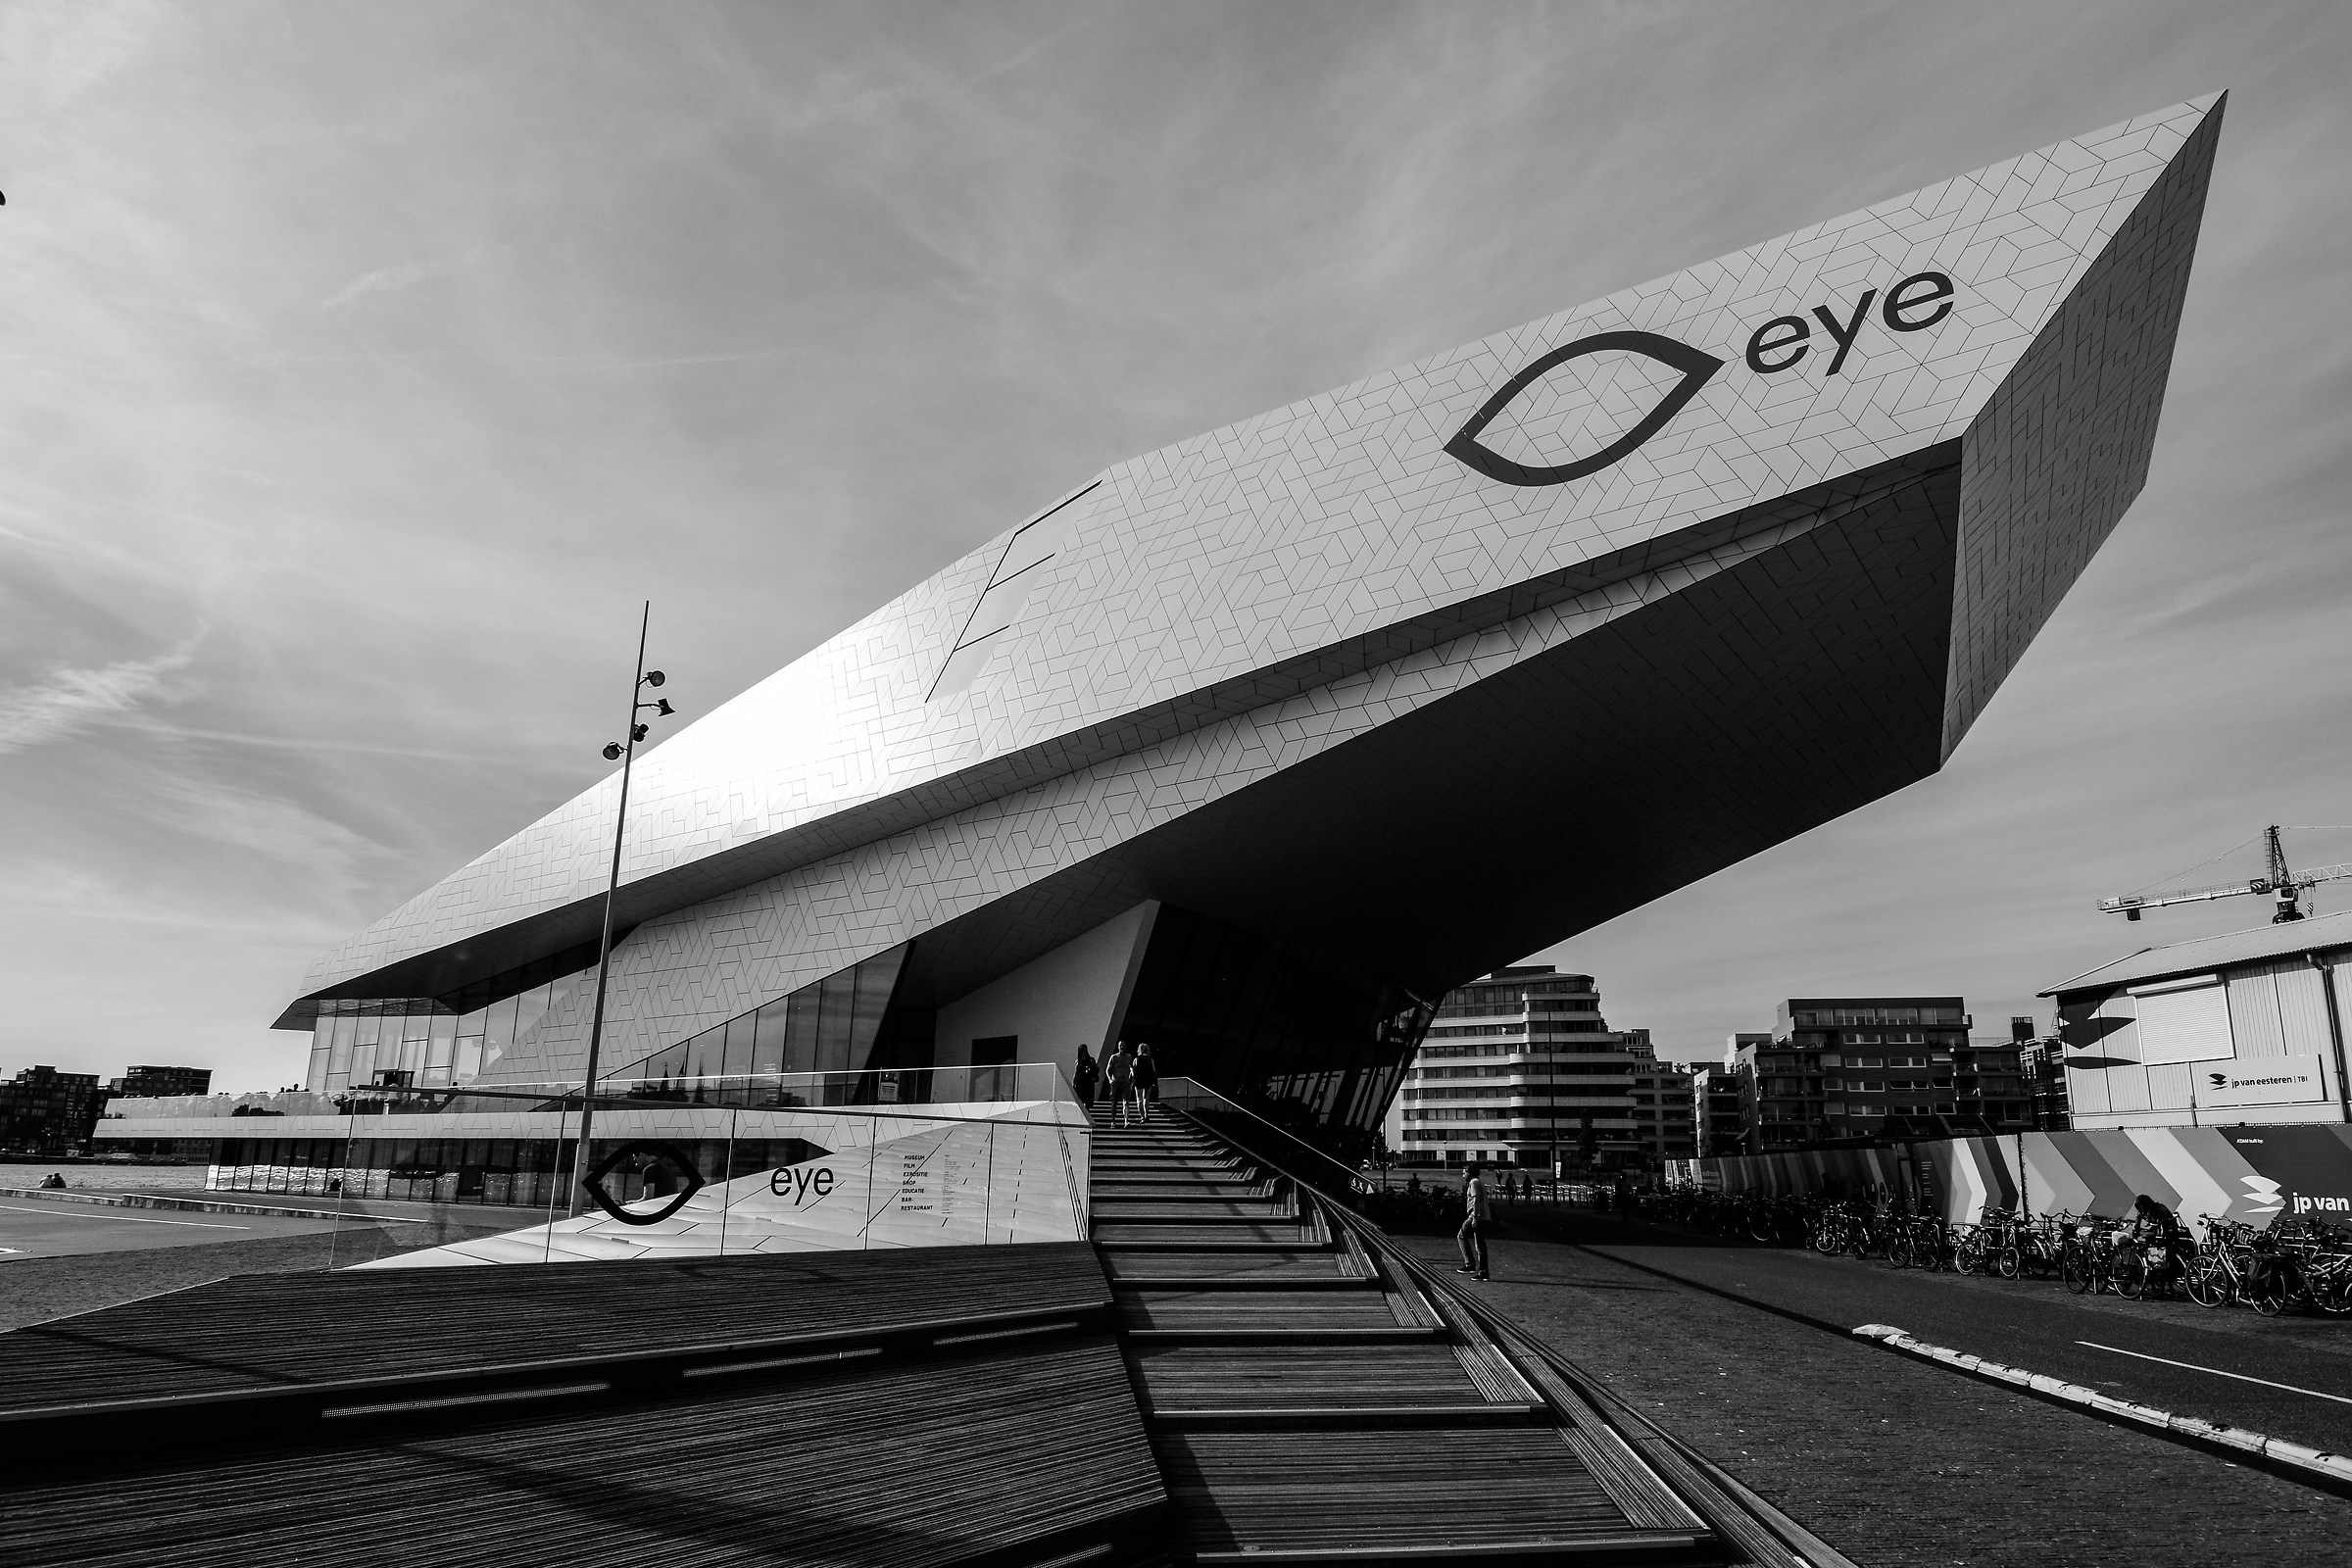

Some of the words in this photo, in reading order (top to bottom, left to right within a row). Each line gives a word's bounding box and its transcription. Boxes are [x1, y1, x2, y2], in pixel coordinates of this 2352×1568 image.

[1745, 270, 1955, 377] eye
[2231, 1079, 2240, 1089] jp
[2256, 1076, 2293, 1086] eesteren
[770, 1167, 834, 1206] eye
[2292, 1192, 2312, 1214] jp
[2313, 1197, 2350, 1211] van
